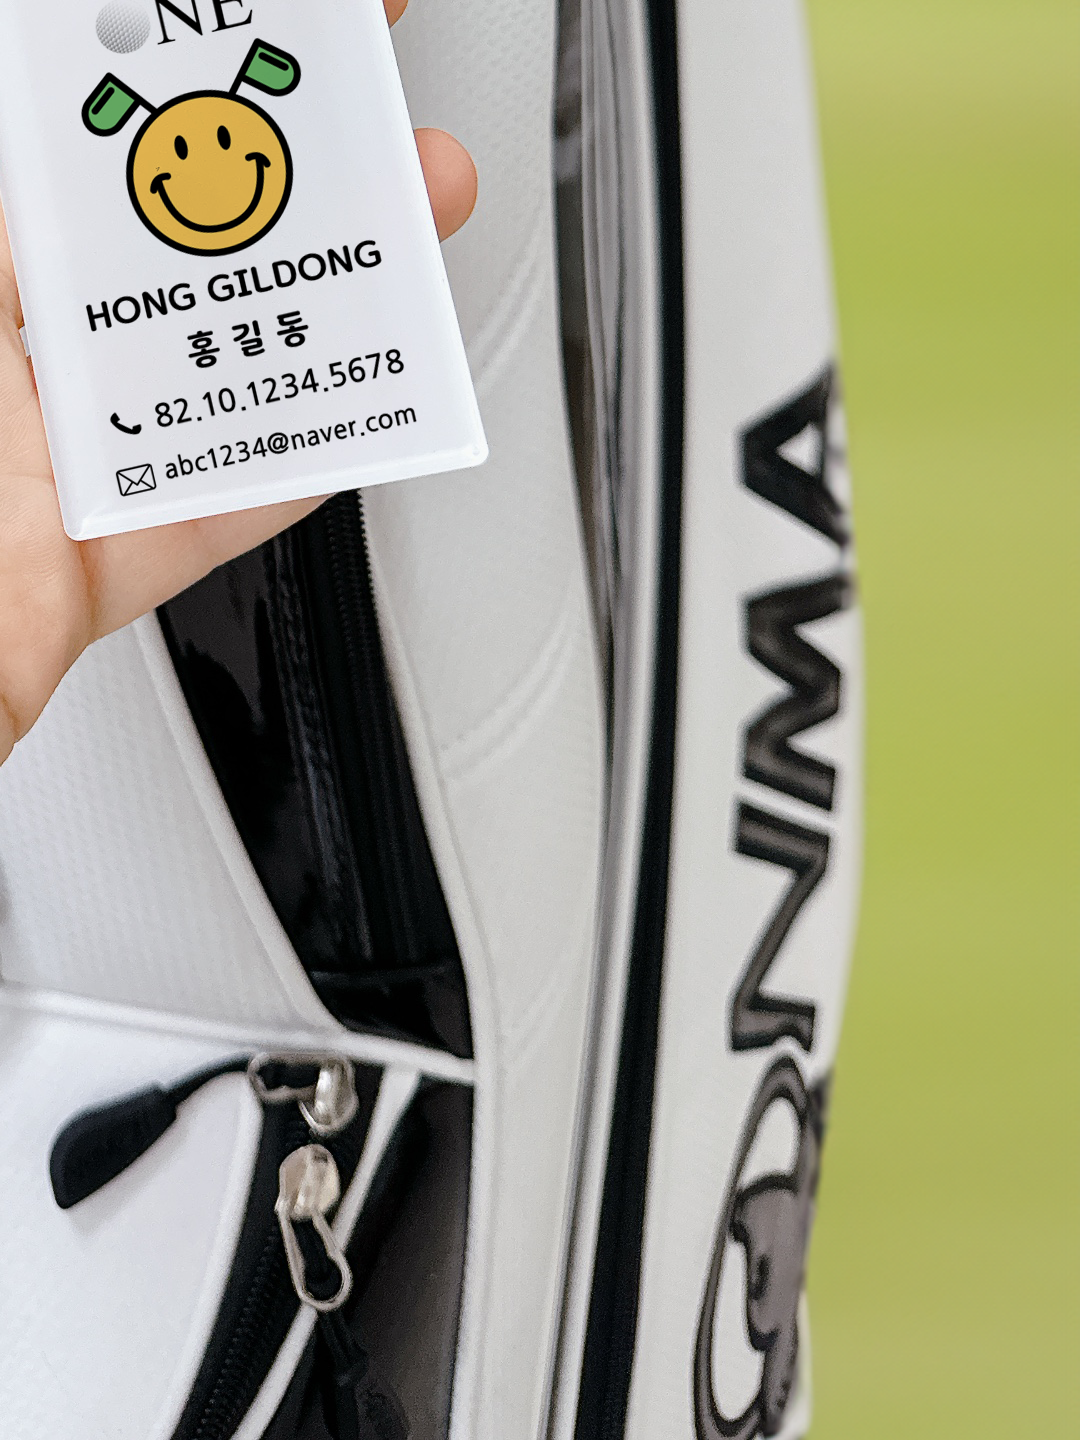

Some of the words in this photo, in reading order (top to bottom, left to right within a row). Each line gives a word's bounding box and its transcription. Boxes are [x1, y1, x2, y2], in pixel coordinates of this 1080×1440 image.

[85, 282, 197, 332] HONG
[207, 239, 383, 303] GILDONG
[154, 348, 405, 428] 82.10.1234.5678
[165, 407, 418, 480] abc1234@naver.com
